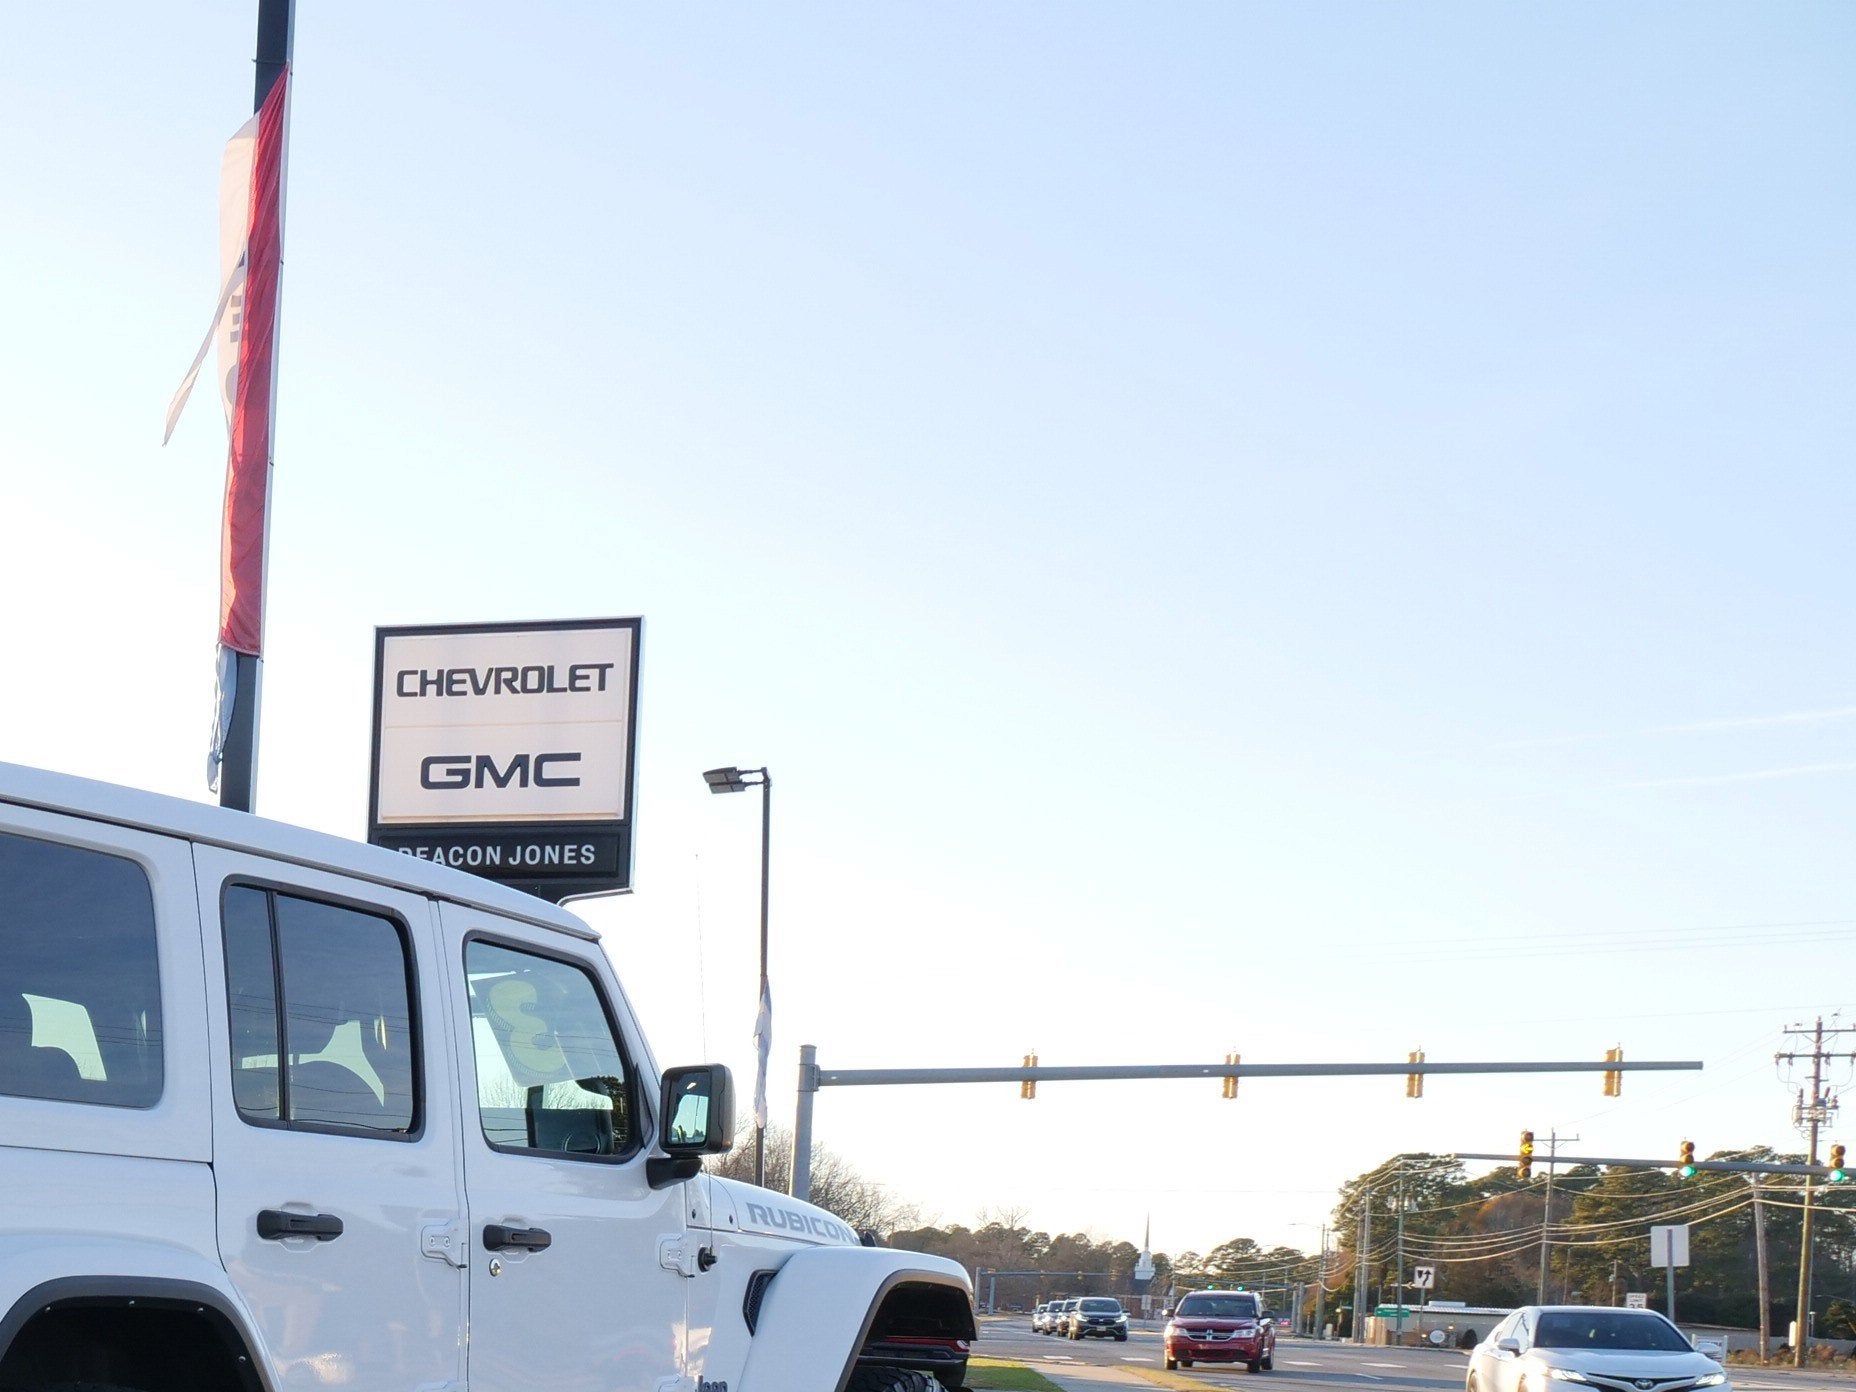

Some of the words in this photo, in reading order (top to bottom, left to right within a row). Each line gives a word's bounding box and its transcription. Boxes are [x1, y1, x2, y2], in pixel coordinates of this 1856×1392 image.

[397, 663, 614, 698] CHEVROLET
[420, 752, 581, 789] GMC
[508, 844, 595, 866] JONES
[746, 1202, 854, 1242] RUBICON
